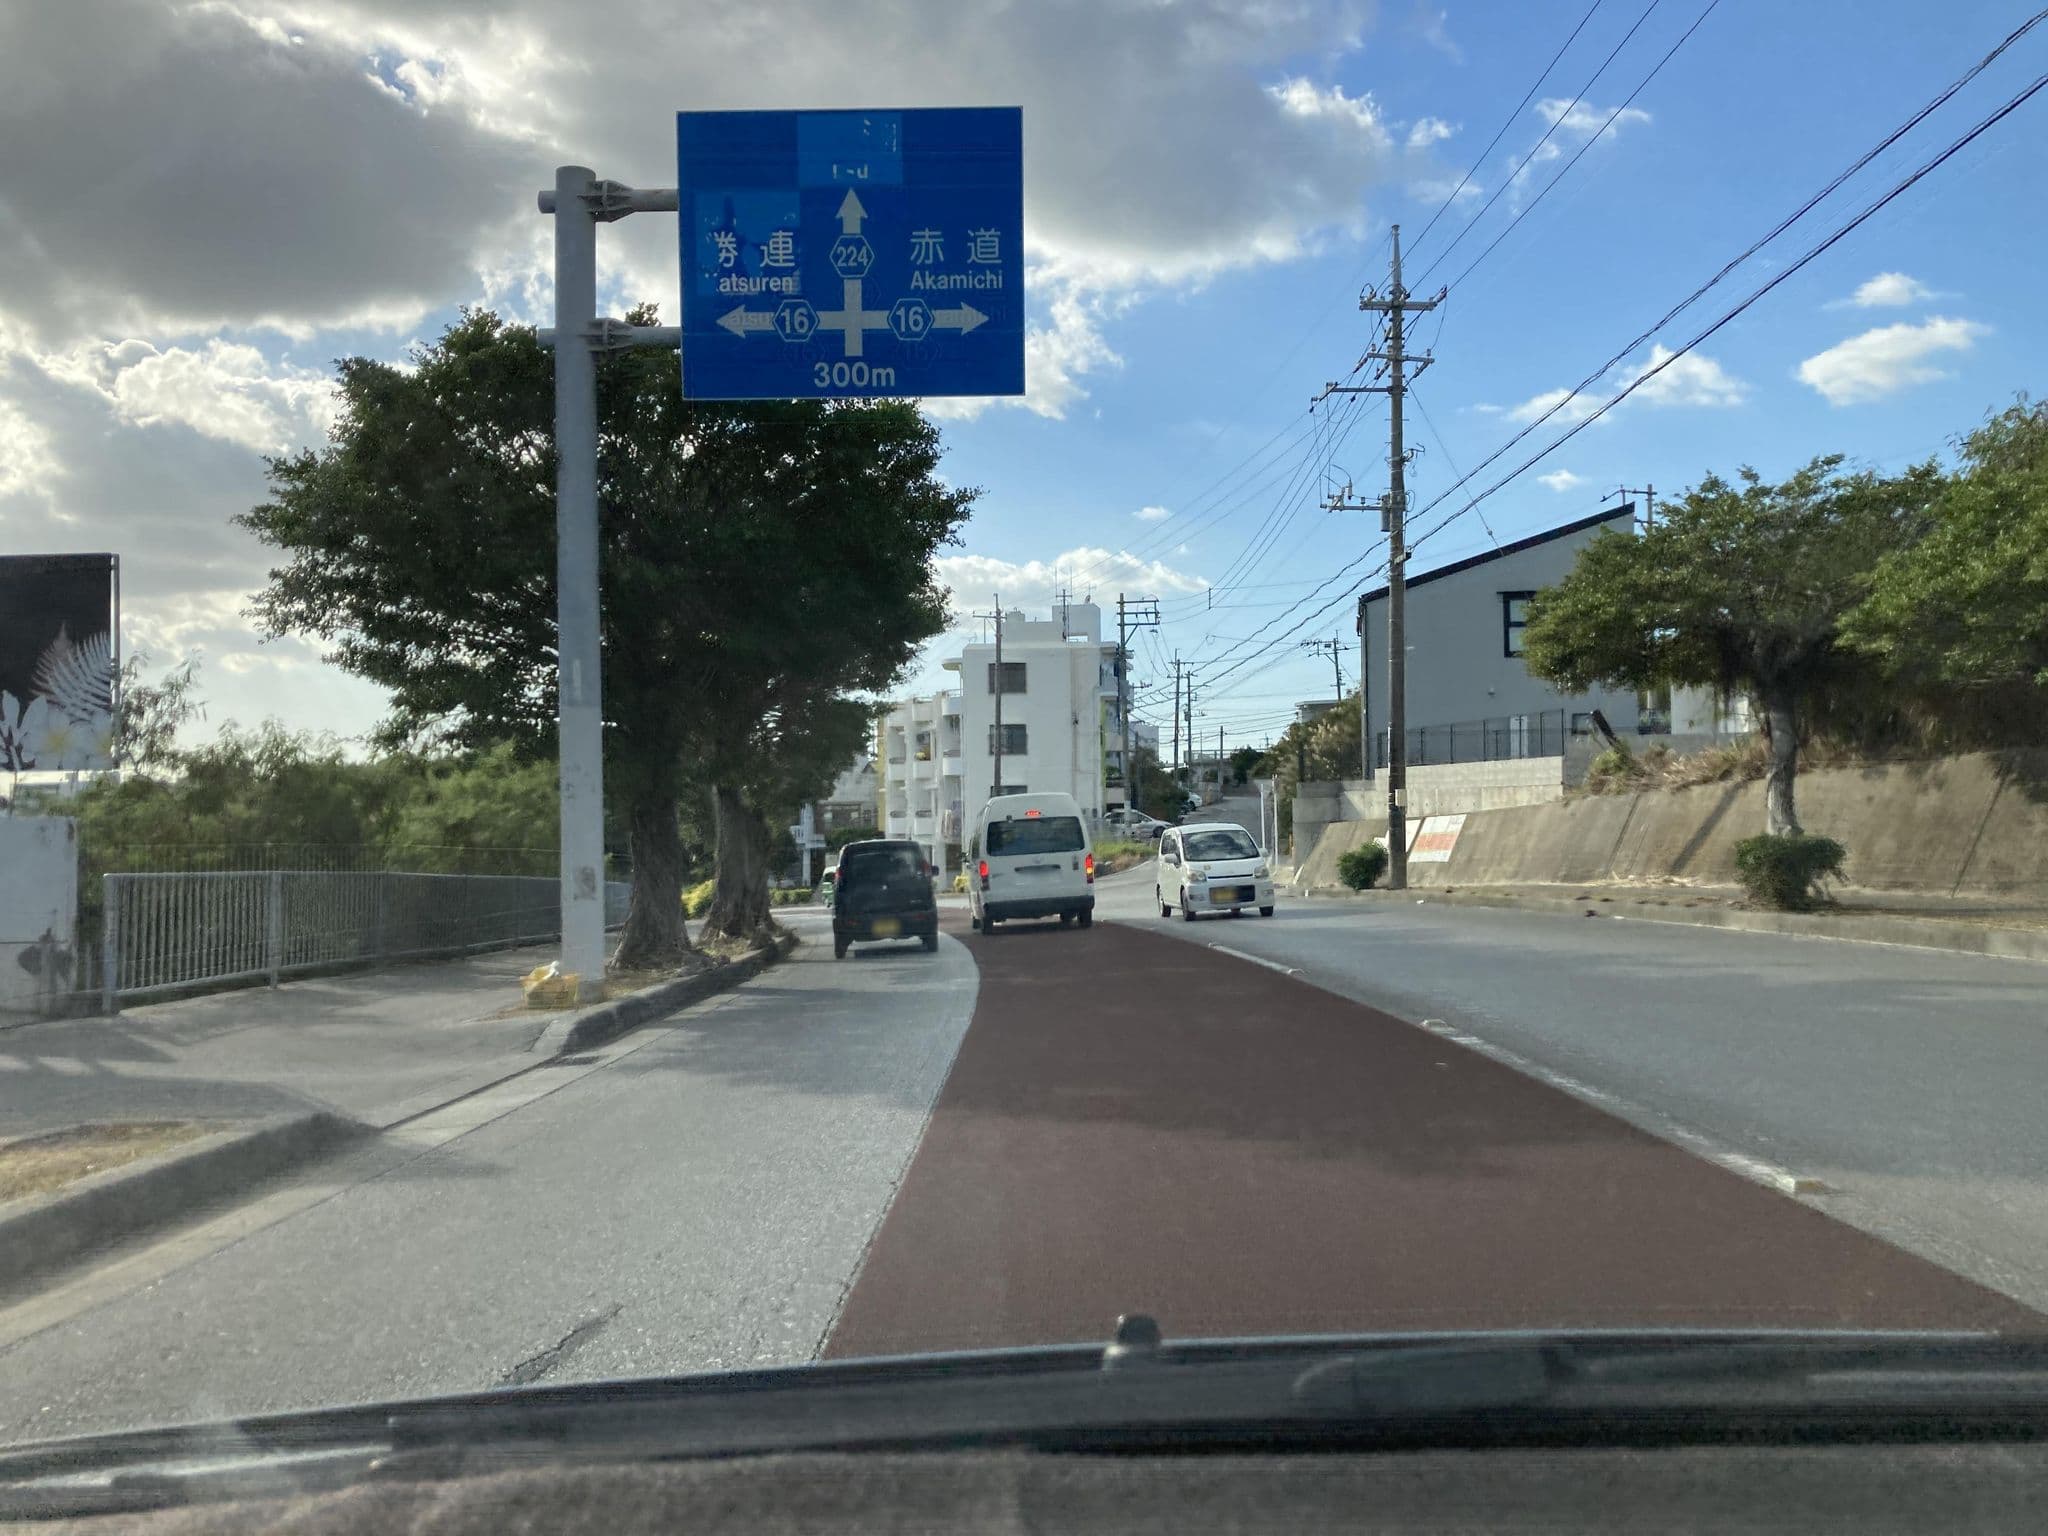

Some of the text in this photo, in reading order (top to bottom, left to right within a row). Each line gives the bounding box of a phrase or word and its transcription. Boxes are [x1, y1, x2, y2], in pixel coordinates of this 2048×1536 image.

[837, 246, 869, 267] 224
[910, 227, 1002, 265] 赤道
[716, 273, 793, 293] atsuren
[910, 269, 1003, 290] Akamichi
[780, 307, 809, 335] 16
[896, 305, 924, 332] 16
[814, 361, 896, 388] 300m
